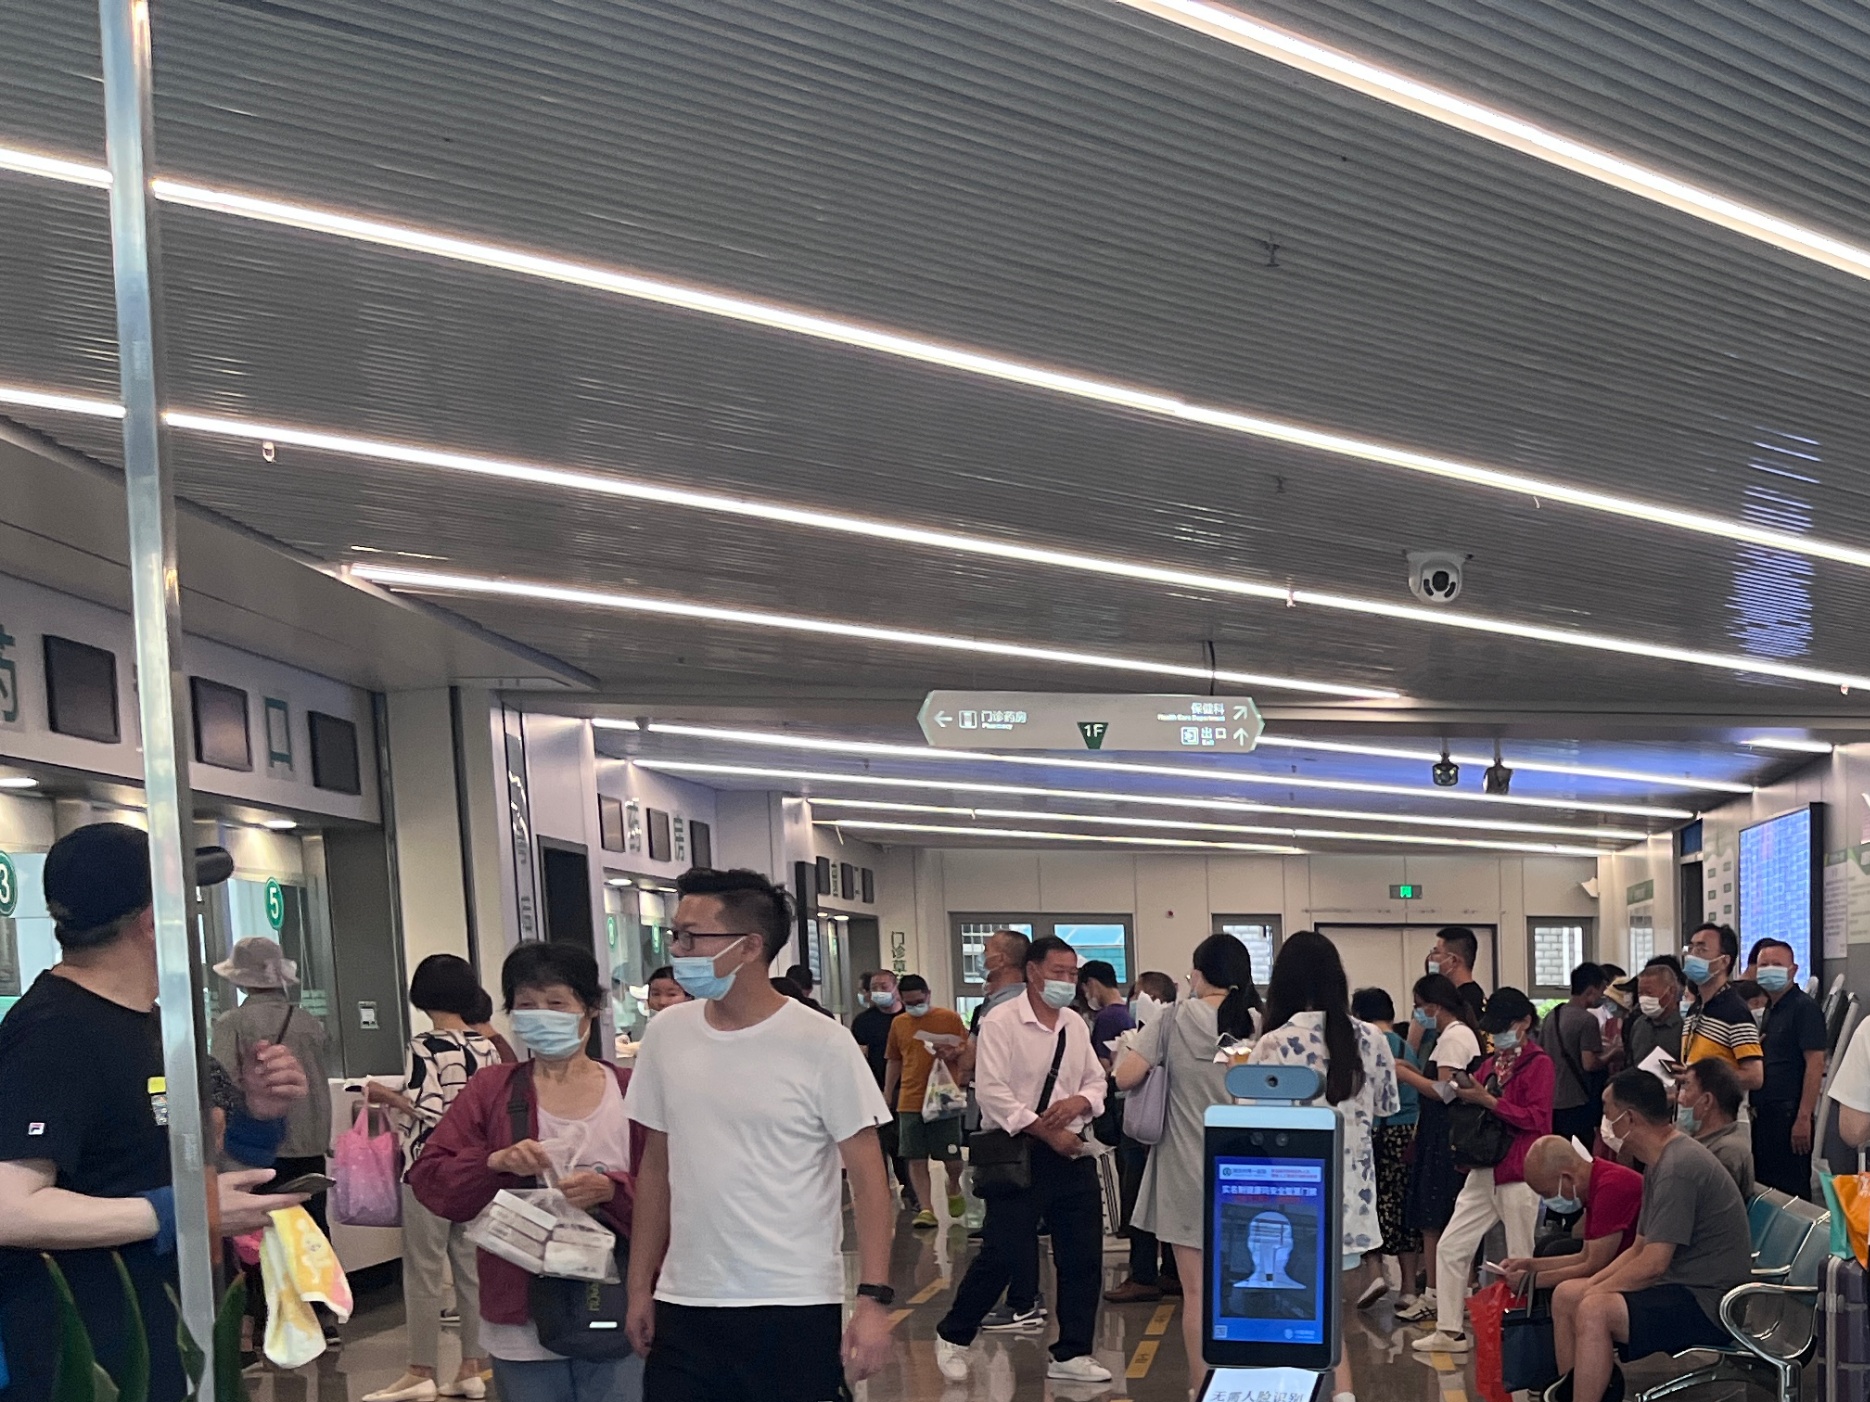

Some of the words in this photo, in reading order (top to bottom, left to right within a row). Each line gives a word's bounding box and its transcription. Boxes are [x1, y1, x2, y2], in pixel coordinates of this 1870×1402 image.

[1191, 702, 1225, 715] 保健科
[981, 710, 1028, 724] 门诊药房
[1084, 723, 1104, 738] 1F
[1201, 727, 1227, 740] 出口
